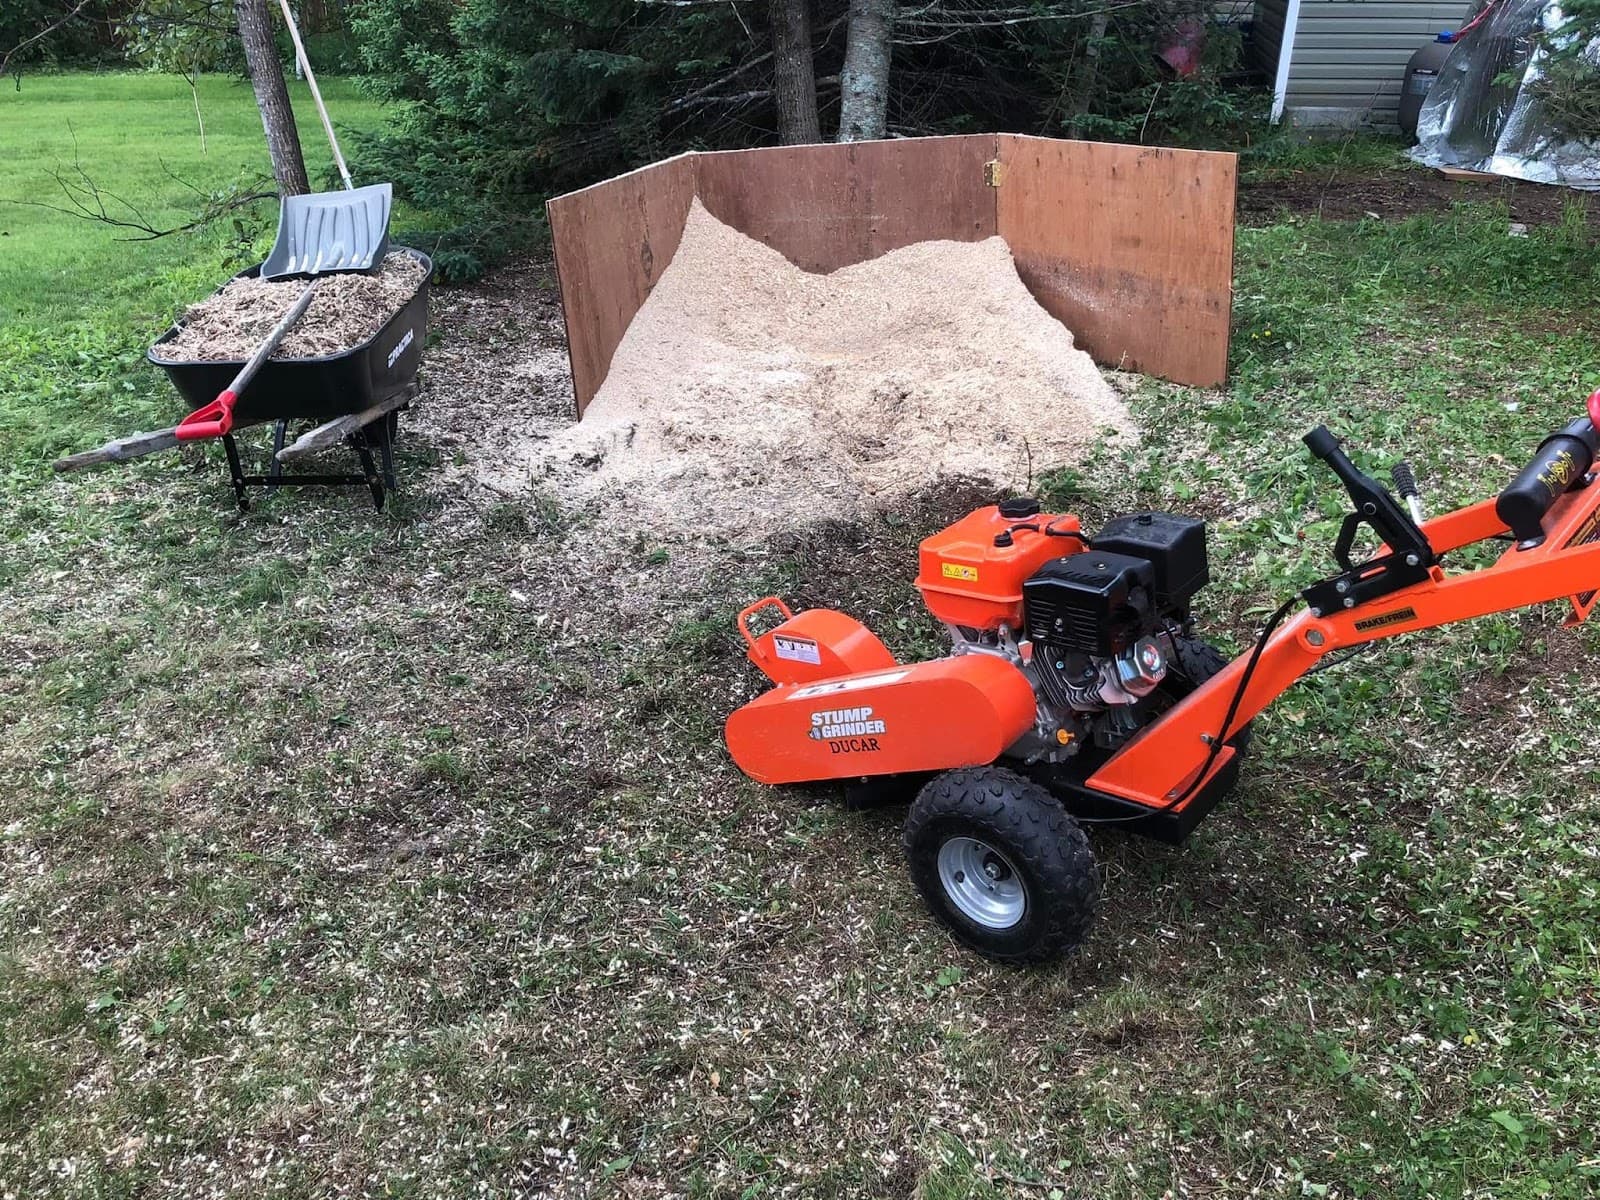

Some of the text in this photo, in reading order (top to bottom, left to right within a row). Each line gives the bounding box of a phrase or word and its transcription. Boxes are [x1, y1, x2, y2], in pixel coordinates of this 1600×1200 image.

[811, 706, 873, 726] STUMP
[821, 719, 886, 738] GRINDER
[829, 738, 880, 754] DUCAR
